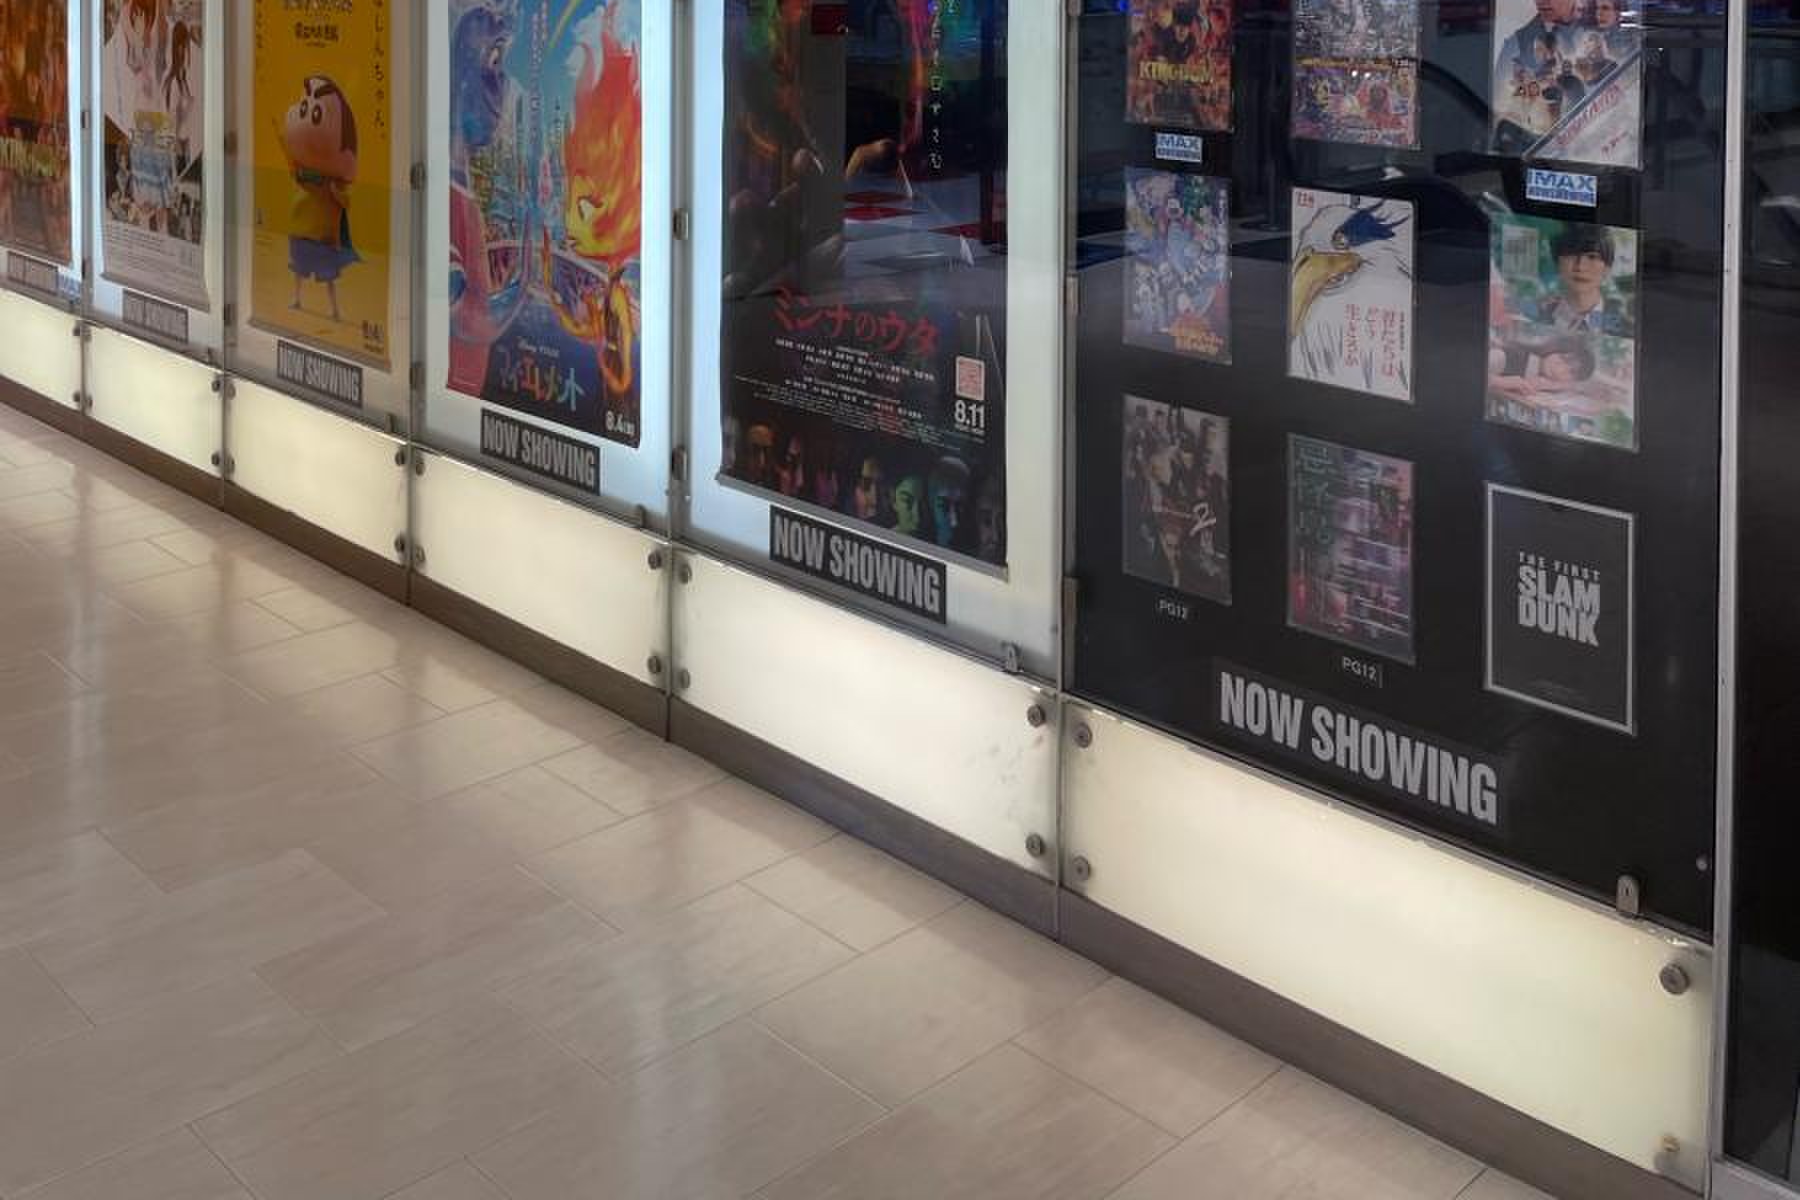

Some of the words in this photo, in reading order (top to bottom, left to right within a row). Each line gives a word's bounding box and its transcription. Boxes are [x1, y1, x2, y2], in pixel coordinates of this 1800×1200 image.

[1529, 171, 1594, 191] IMAX
[771, 285, 941, 358] ミンナのウタ
[304, 352, 360, 408] SHOWING
[953, 399, 986, 429] 8.11
[483, 413, 520, 457] NOW
[521, 429, 595, 486] SHOWING
[772, 511, 825, 571] NOW
[829, 533, 940, 615] SHOWING
[1518, 564, 1601, 614] SLAM
[1518, 594, 1600, 648] DUNK
[1341, 656, 1378, 682] PG12
[1220, 671, 1304, 750] NOW
[1311, 704, 1498, 825] SHOWING
